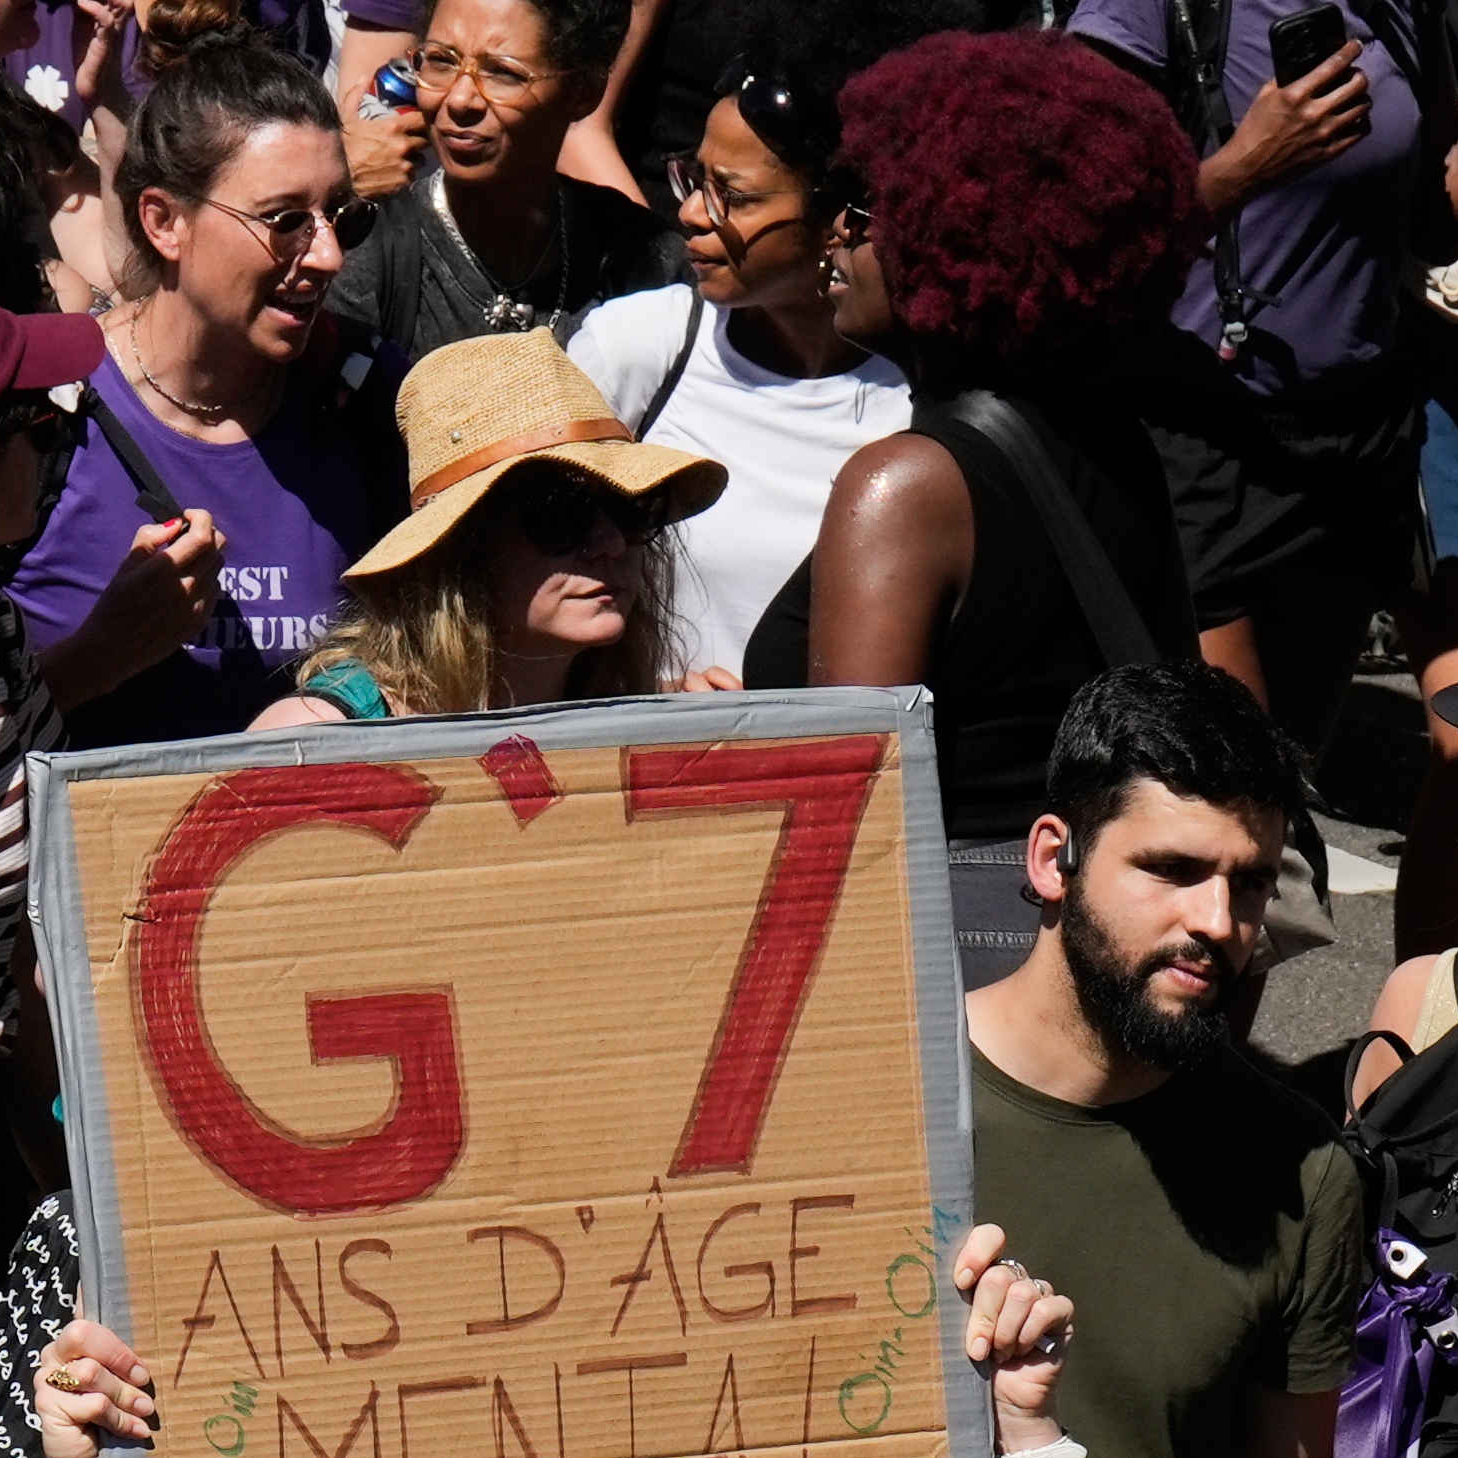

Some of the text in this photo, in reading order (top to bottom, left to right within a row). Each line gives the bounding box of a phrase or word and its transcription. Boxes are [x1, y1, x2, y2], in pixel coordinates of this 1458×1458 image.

[135, 732, 891, 1220] G'7
[50, 1266, 77, 1314] mo
[173, 1176, 857, 1390] ANS D'ÂGE
[10, 1381, 43, 1432] mo
